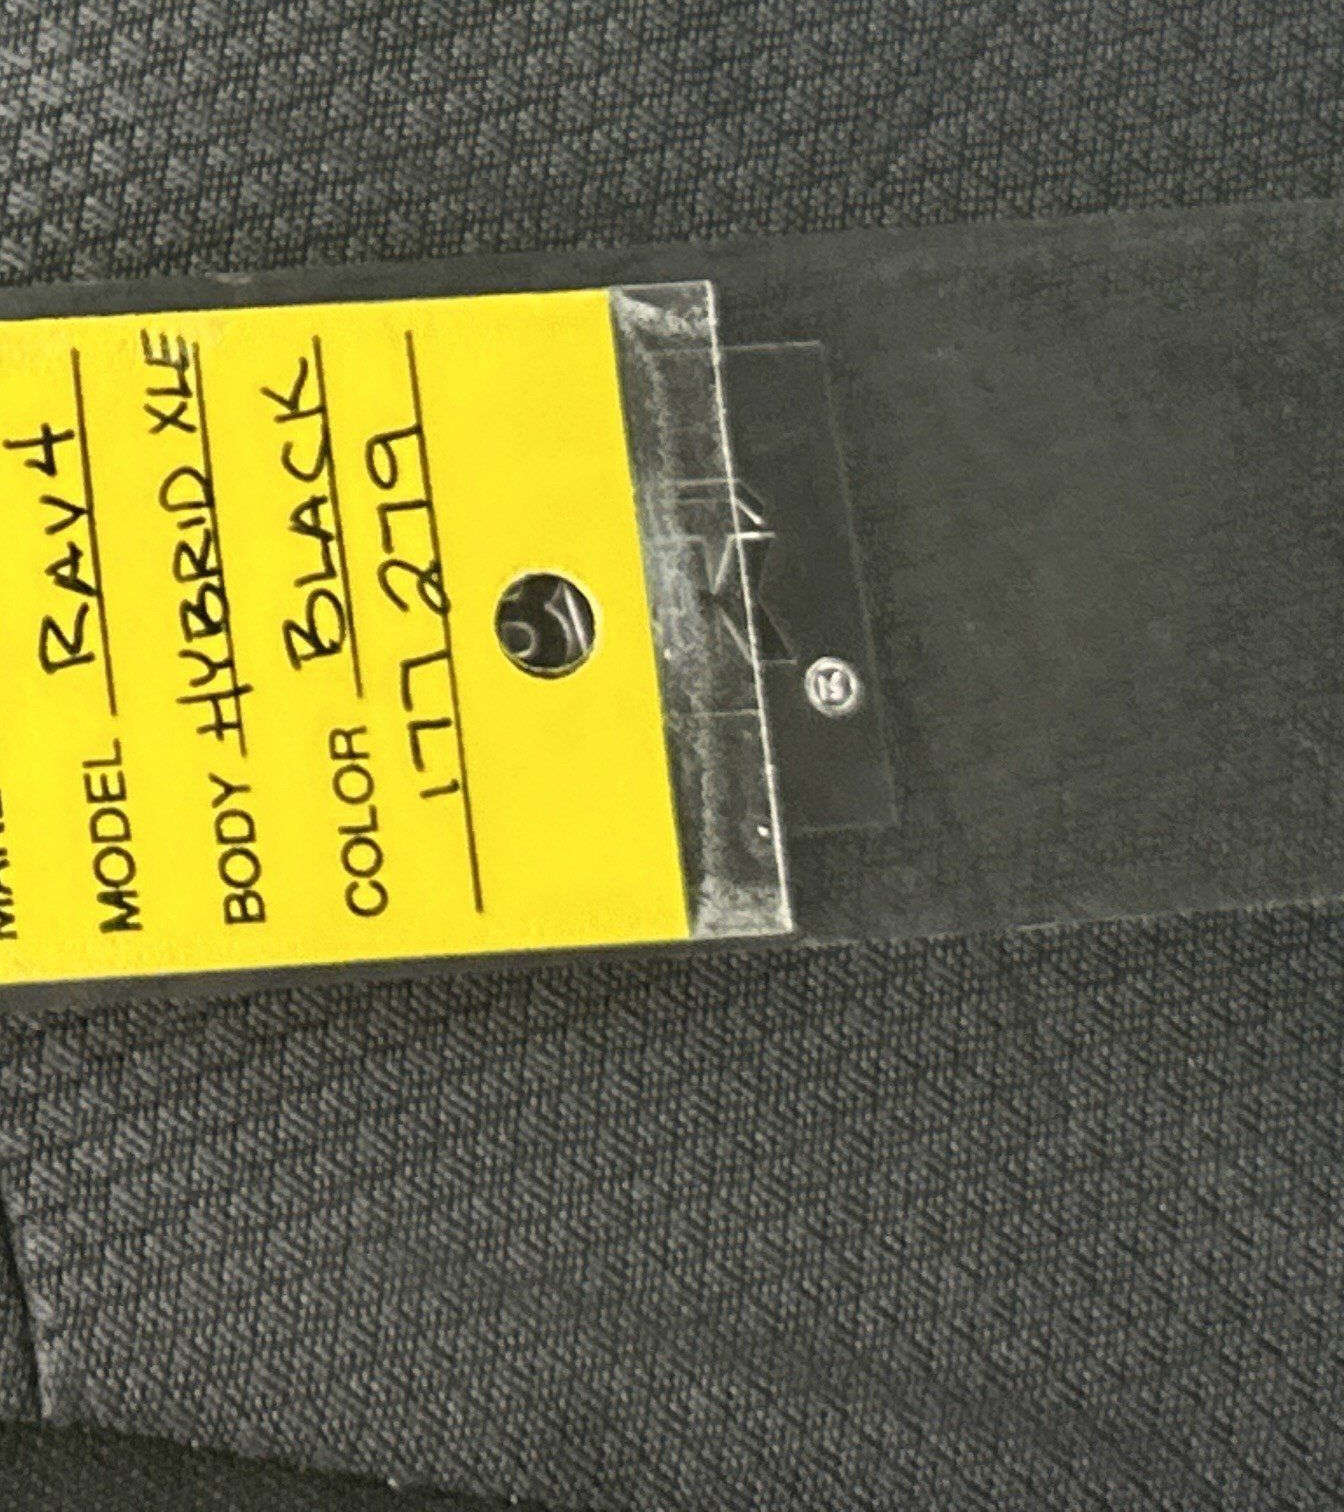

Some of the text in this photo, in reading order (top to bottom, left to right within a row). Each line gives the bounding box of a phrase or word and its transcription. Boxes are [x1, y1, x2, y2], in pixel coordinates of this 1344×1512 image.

[2, 423, 97, 674] RAV4
[140, 328, 253, 740] HYBRID XLE
[259, 355, 347, 669] BLACK
[82, 737, 143, 932] MODEL
[209, 772, 266, 924] BODY
[328, 725, 389, 916] COLOR
